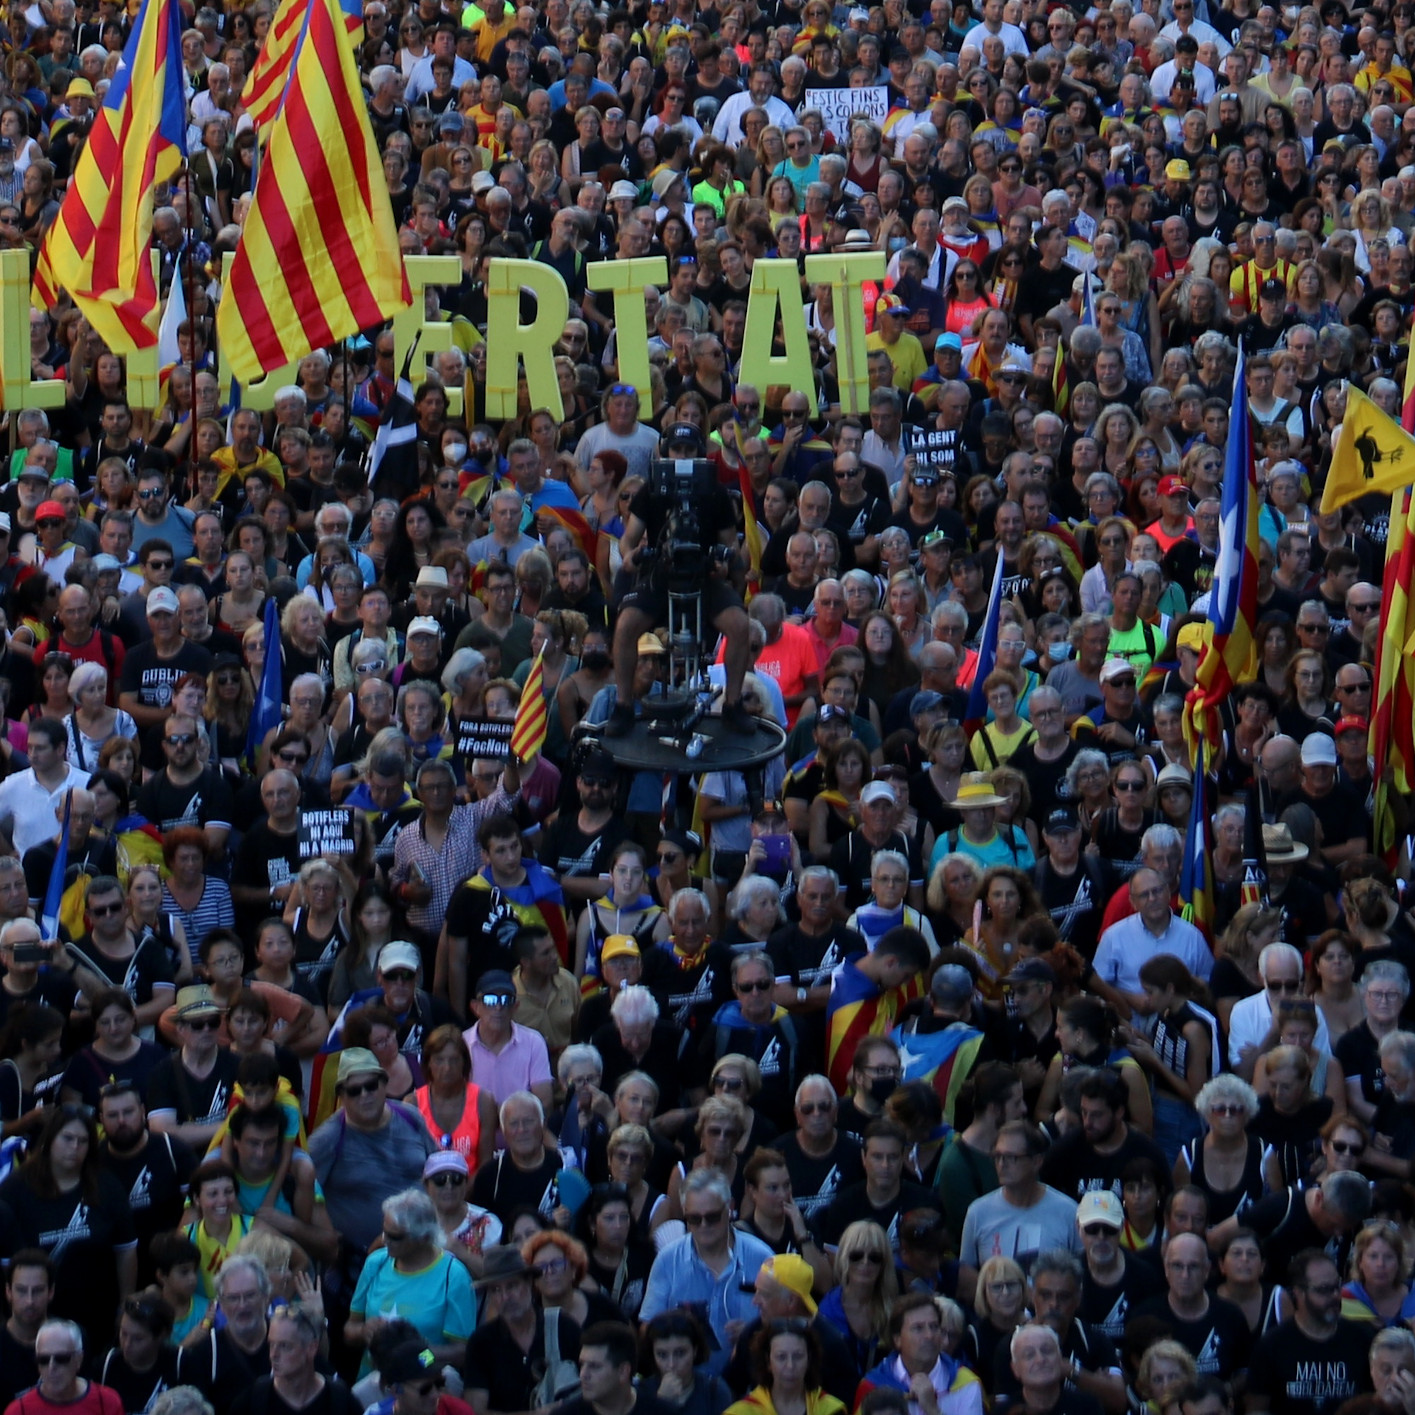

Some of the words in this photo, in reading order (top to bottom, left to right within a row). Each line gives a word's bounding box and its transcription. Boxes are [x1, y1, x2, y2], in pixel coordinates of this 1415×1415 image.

[851, 88, 881, 105] FINS
[912, 433, 926, 448] LA
[928, 430, 956, 446] GENT
[931, 448, 955, 464] SOM
[460, 720, 478, 734] FORA
[458, 736, 509, 755] #FocNou
[302, 809, 350, 827] BOTIFLERS
[312, 840, 319, 855] A
[320, 838, 354, 855] MADRID
[1296, 1361, 1321, 1381] MAI
[1327, 1361, 1346, 1381] NO
